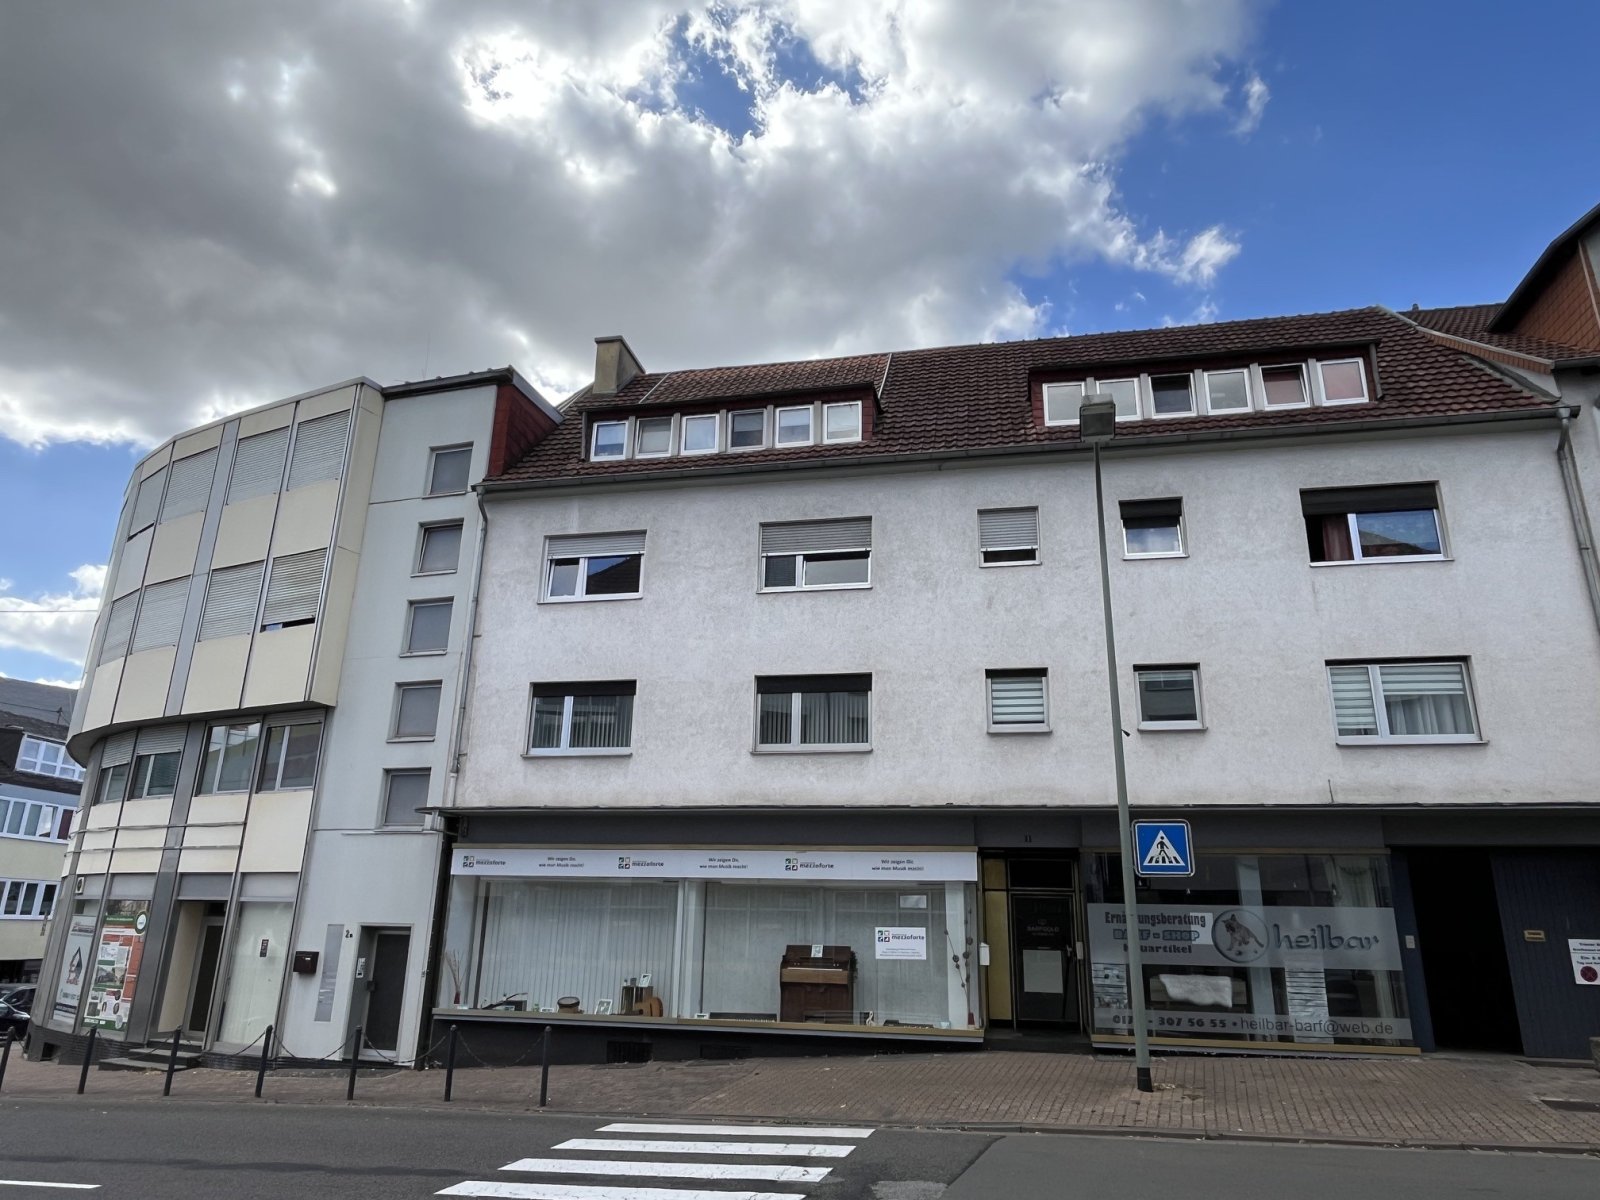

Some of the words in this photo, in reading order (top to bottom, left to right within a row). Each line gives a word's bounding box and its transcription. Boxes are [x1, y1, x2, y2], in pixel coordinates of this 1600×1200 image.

[1105, 911, 1206, 927] Ernäungsberatung
[1162, 929, 1200, 941] SHOP
[1273, 923, 1379, 950] heilbar
[1113, 1014, 1134, 1025] 017
[1158, 1016, 1182, 1027] 307
[1210, 1019, 1226, 1029] 55
[1240, 1017, 1393, 1035] heilbar-barf@web.de
